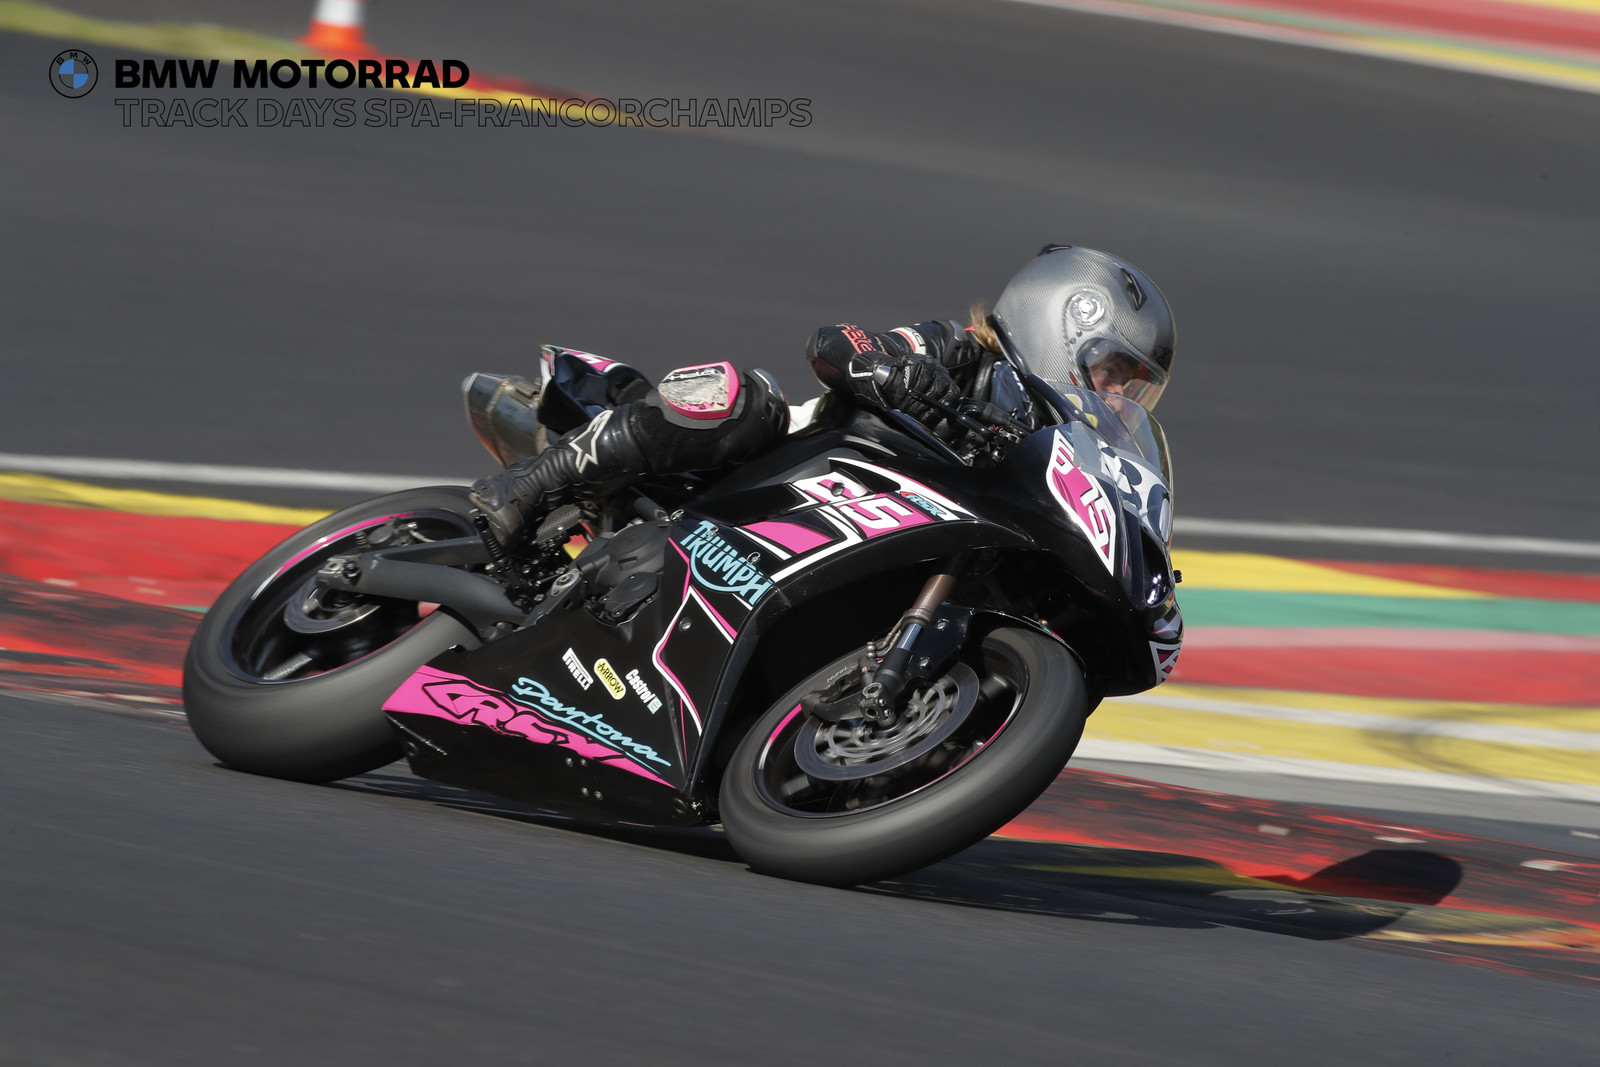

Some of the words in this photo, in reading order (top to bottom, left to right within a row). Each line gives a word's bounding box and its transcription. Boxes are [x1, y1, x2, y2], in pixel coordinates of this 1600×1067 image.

[680, 520, 774, 606] TRIUMPH
[562, 647, 594, 691] PIRELLI
[597, 662, 624, 694] ARROW
[625, 668, 656, 704] Castrol
[511, 676, 673, 768] Daytona
